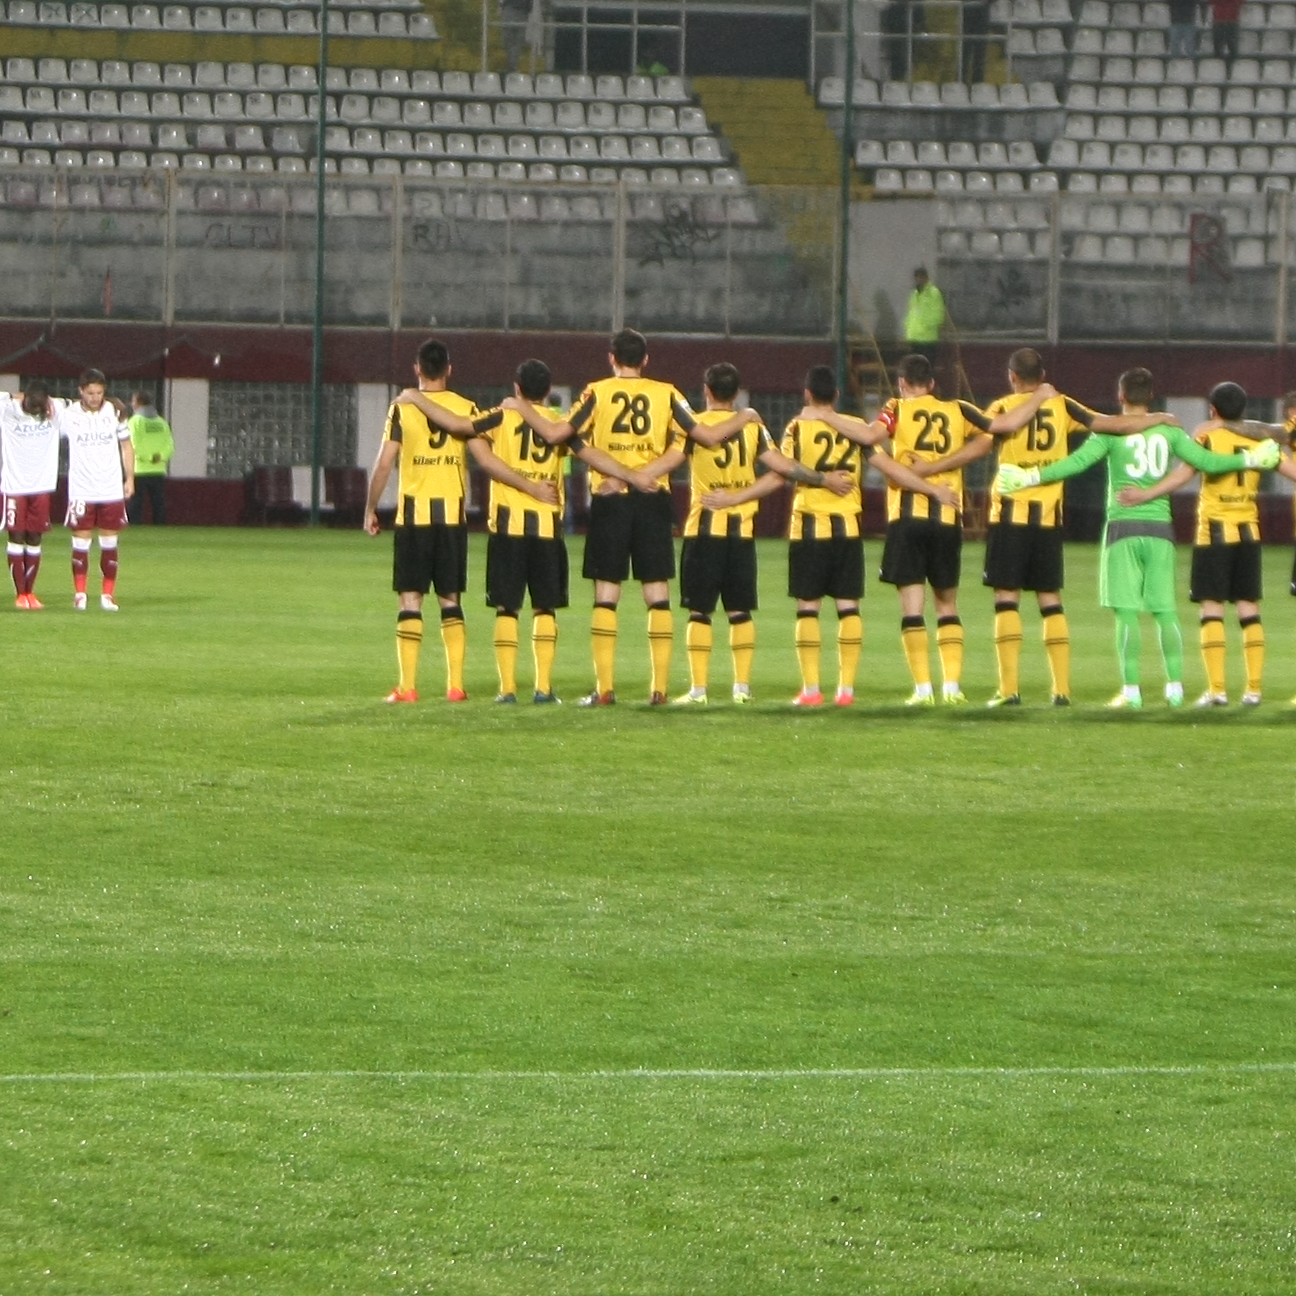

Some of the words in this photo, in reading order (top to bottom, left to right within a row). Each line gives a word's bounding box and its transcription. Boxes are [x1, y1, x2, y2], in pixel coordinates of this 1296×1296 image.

[14, 421, 53, 433] AZUGA
[611, 391, 652, 436] 28
[912, 409, 952, 454] 23
[1026, 409, 1056, 452] 15
[76, 432, 113, 443] AZUGA
[514, 421, 554, 464] 19
[814, 430, 857, 472] 22
[1125, 433, 1169, 479] 30
[7, 510, 16, 526] 3
